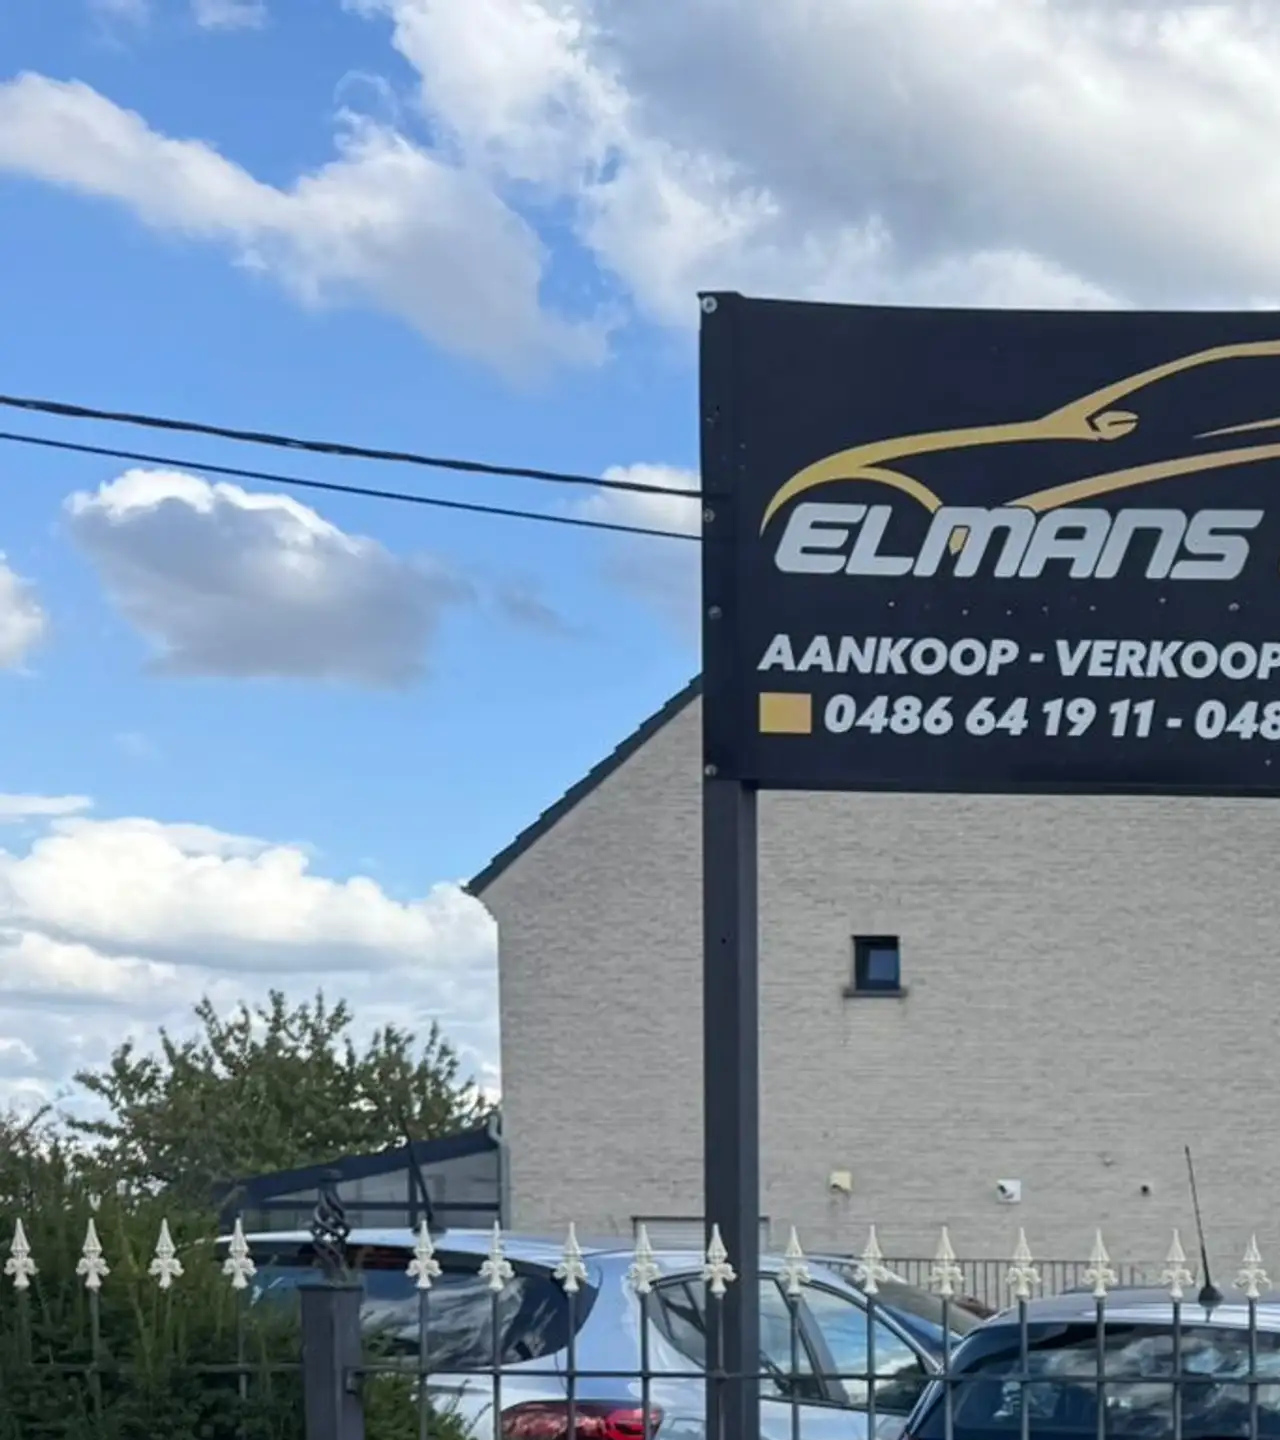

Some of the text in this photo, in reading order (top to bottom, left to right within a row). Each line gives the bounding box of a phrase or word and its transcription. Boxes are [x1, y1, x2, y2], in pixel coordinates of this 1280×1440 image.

[774, 502, 1265, 581] ELMANS
[756, 633, 1020, 676] AANKOOP
[824, 693, 954, 735] 0486
[965, 697, 1029, 736] 64
[1042, 697, 1097, 737] 19
[1109, 698, 1156, 738] 11
